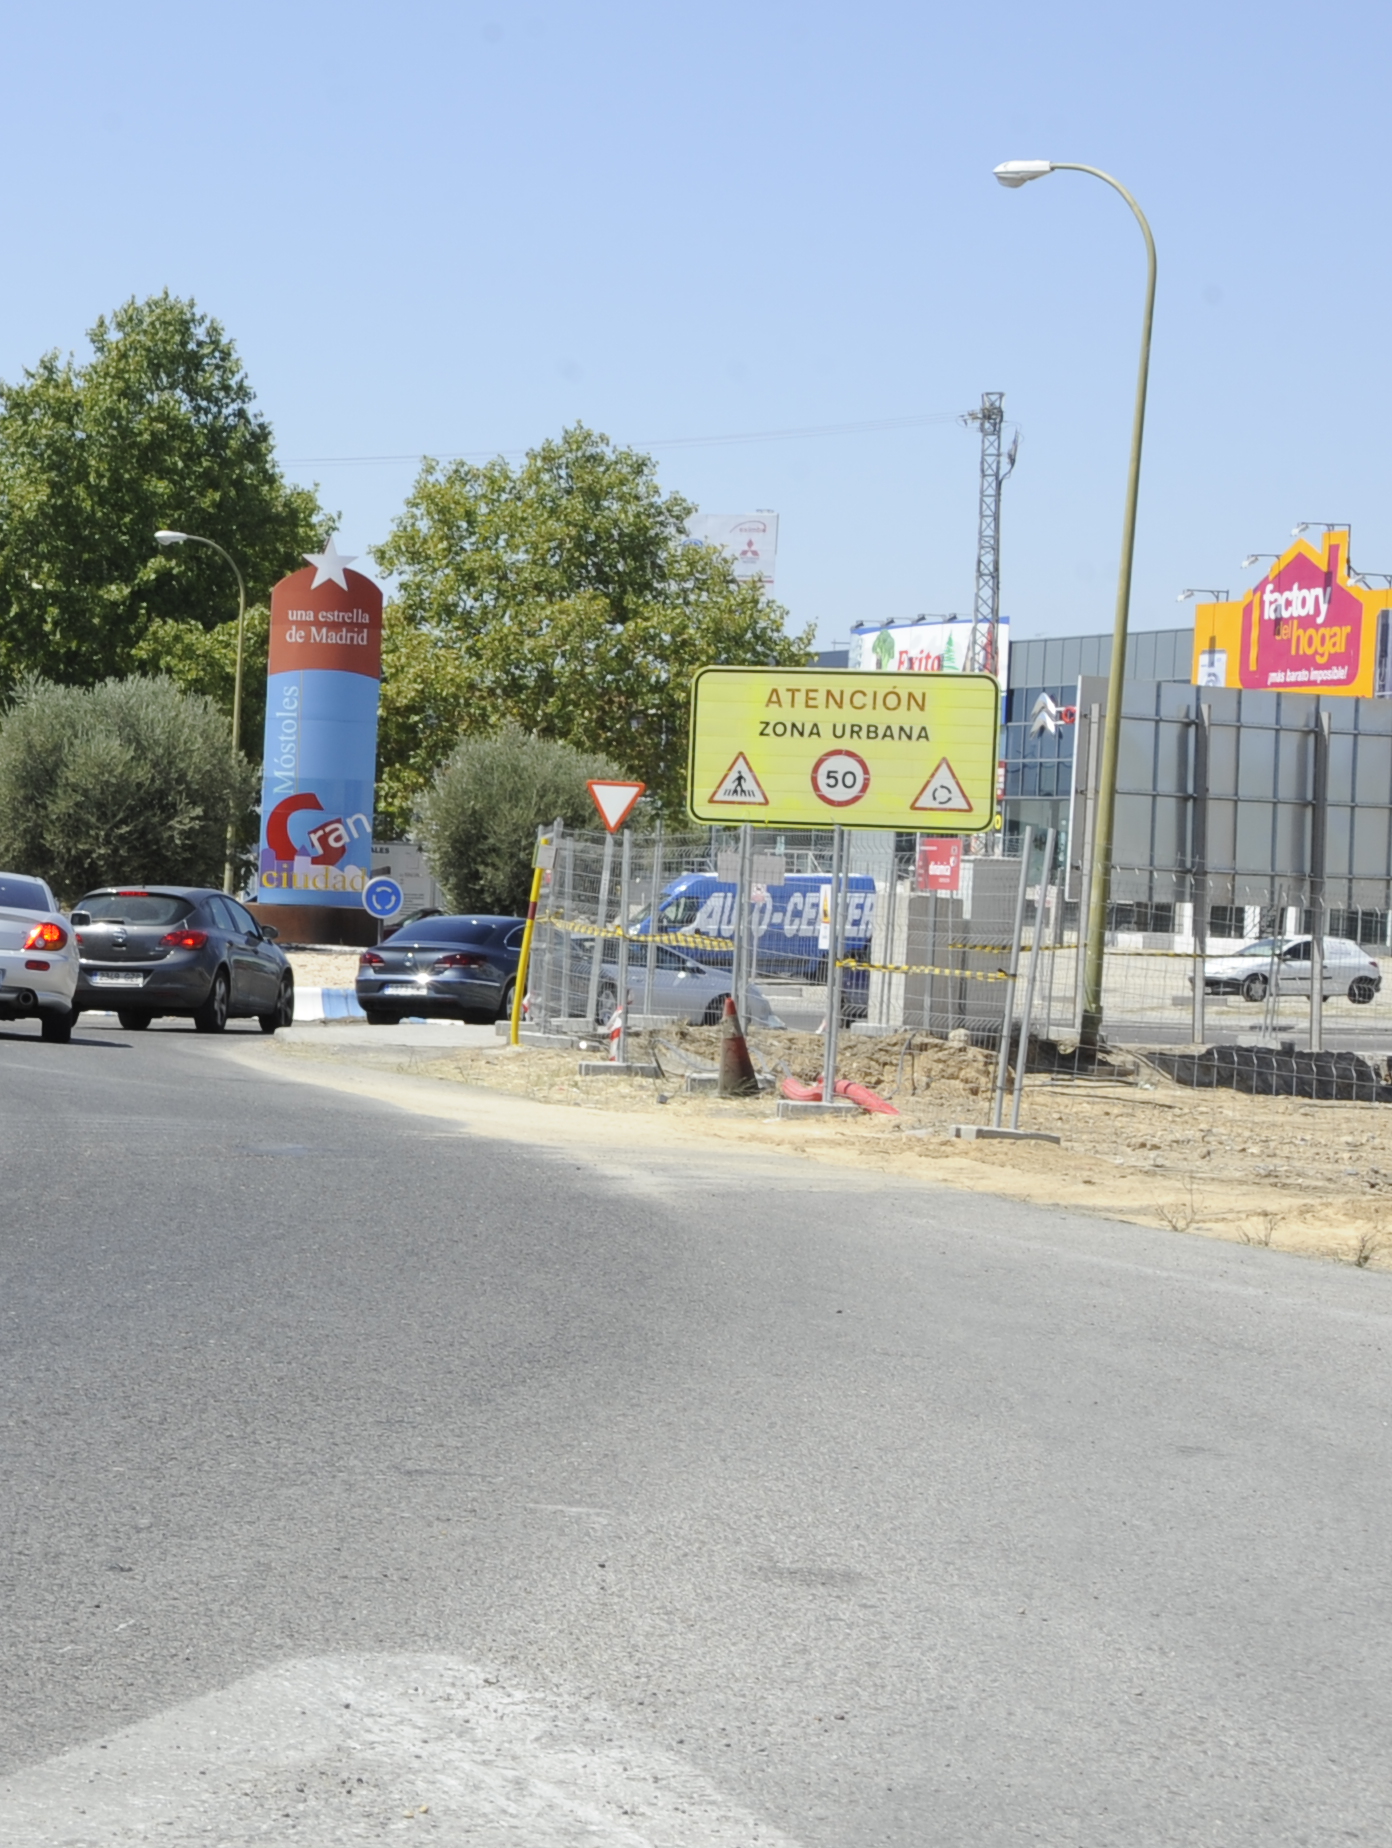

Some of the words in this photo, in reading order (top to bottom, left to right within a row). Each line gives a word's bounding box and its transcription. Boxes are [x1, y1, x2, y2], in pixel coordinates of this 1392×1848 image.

[1263, 582, 1332, 625] factory
[287, 609, 314, 621] una
[318, 608, 370, 623] estrella
[285, 625, 305, 643] de
[310, 626, 368, 645] Madrid
[1275, 620, 1292, 640] del
[1291, 619, 1351, 664] hogar
[1286, 668, 1309, 682] barato
[1310, 665, 1348, 684] imposible!
[765, 686, 926, 712] ATENCIÓN
[273, 685, 299, 795] Móstoles
[759, 721, 822, 738] ZONA
[832, 723, 930, 742] URBANA
[825, 770, 857, 789] 50
[261, 862, 368, 892] ciudad
